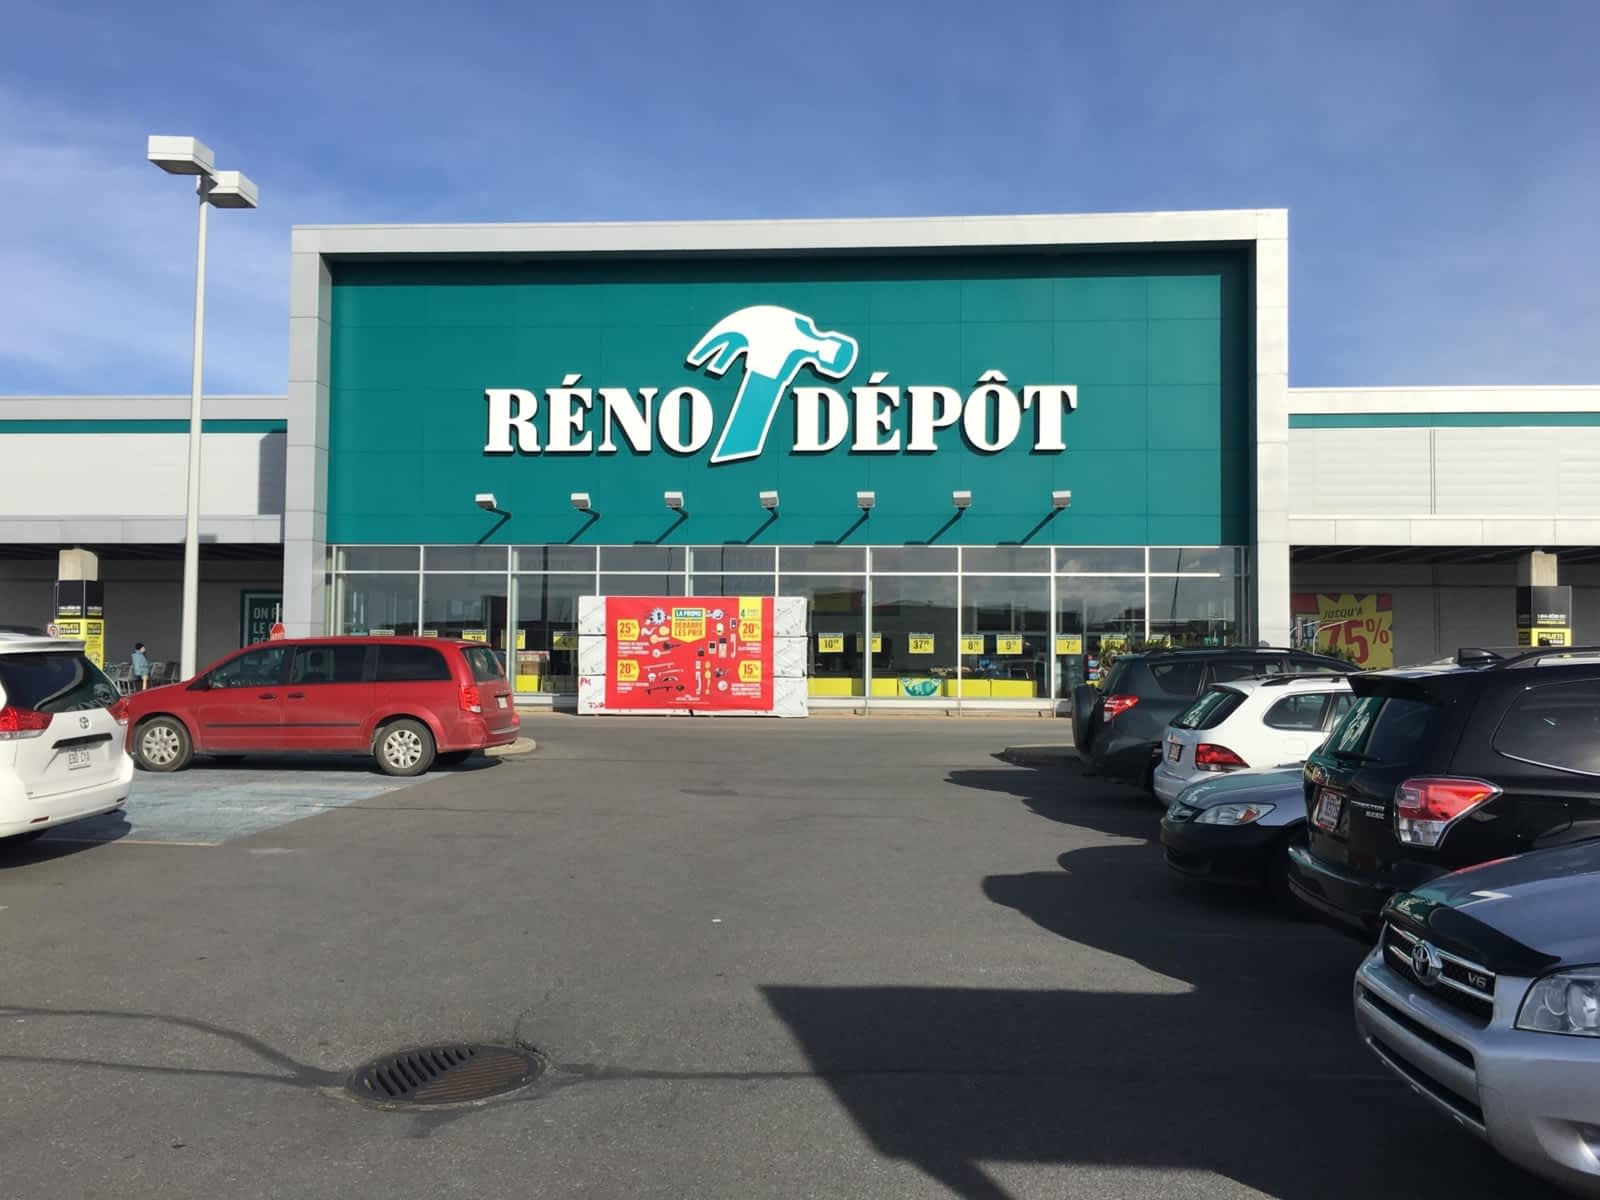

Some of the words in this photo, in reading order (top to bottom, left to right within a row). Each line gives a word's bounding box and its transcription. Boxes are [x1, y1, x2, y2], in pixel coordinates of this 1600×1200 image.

[484, 374, 714, 453] RÉNO
[792, 370, 1078, 452] DÉPÔT
[1467, 971, 1488, 987] V6
